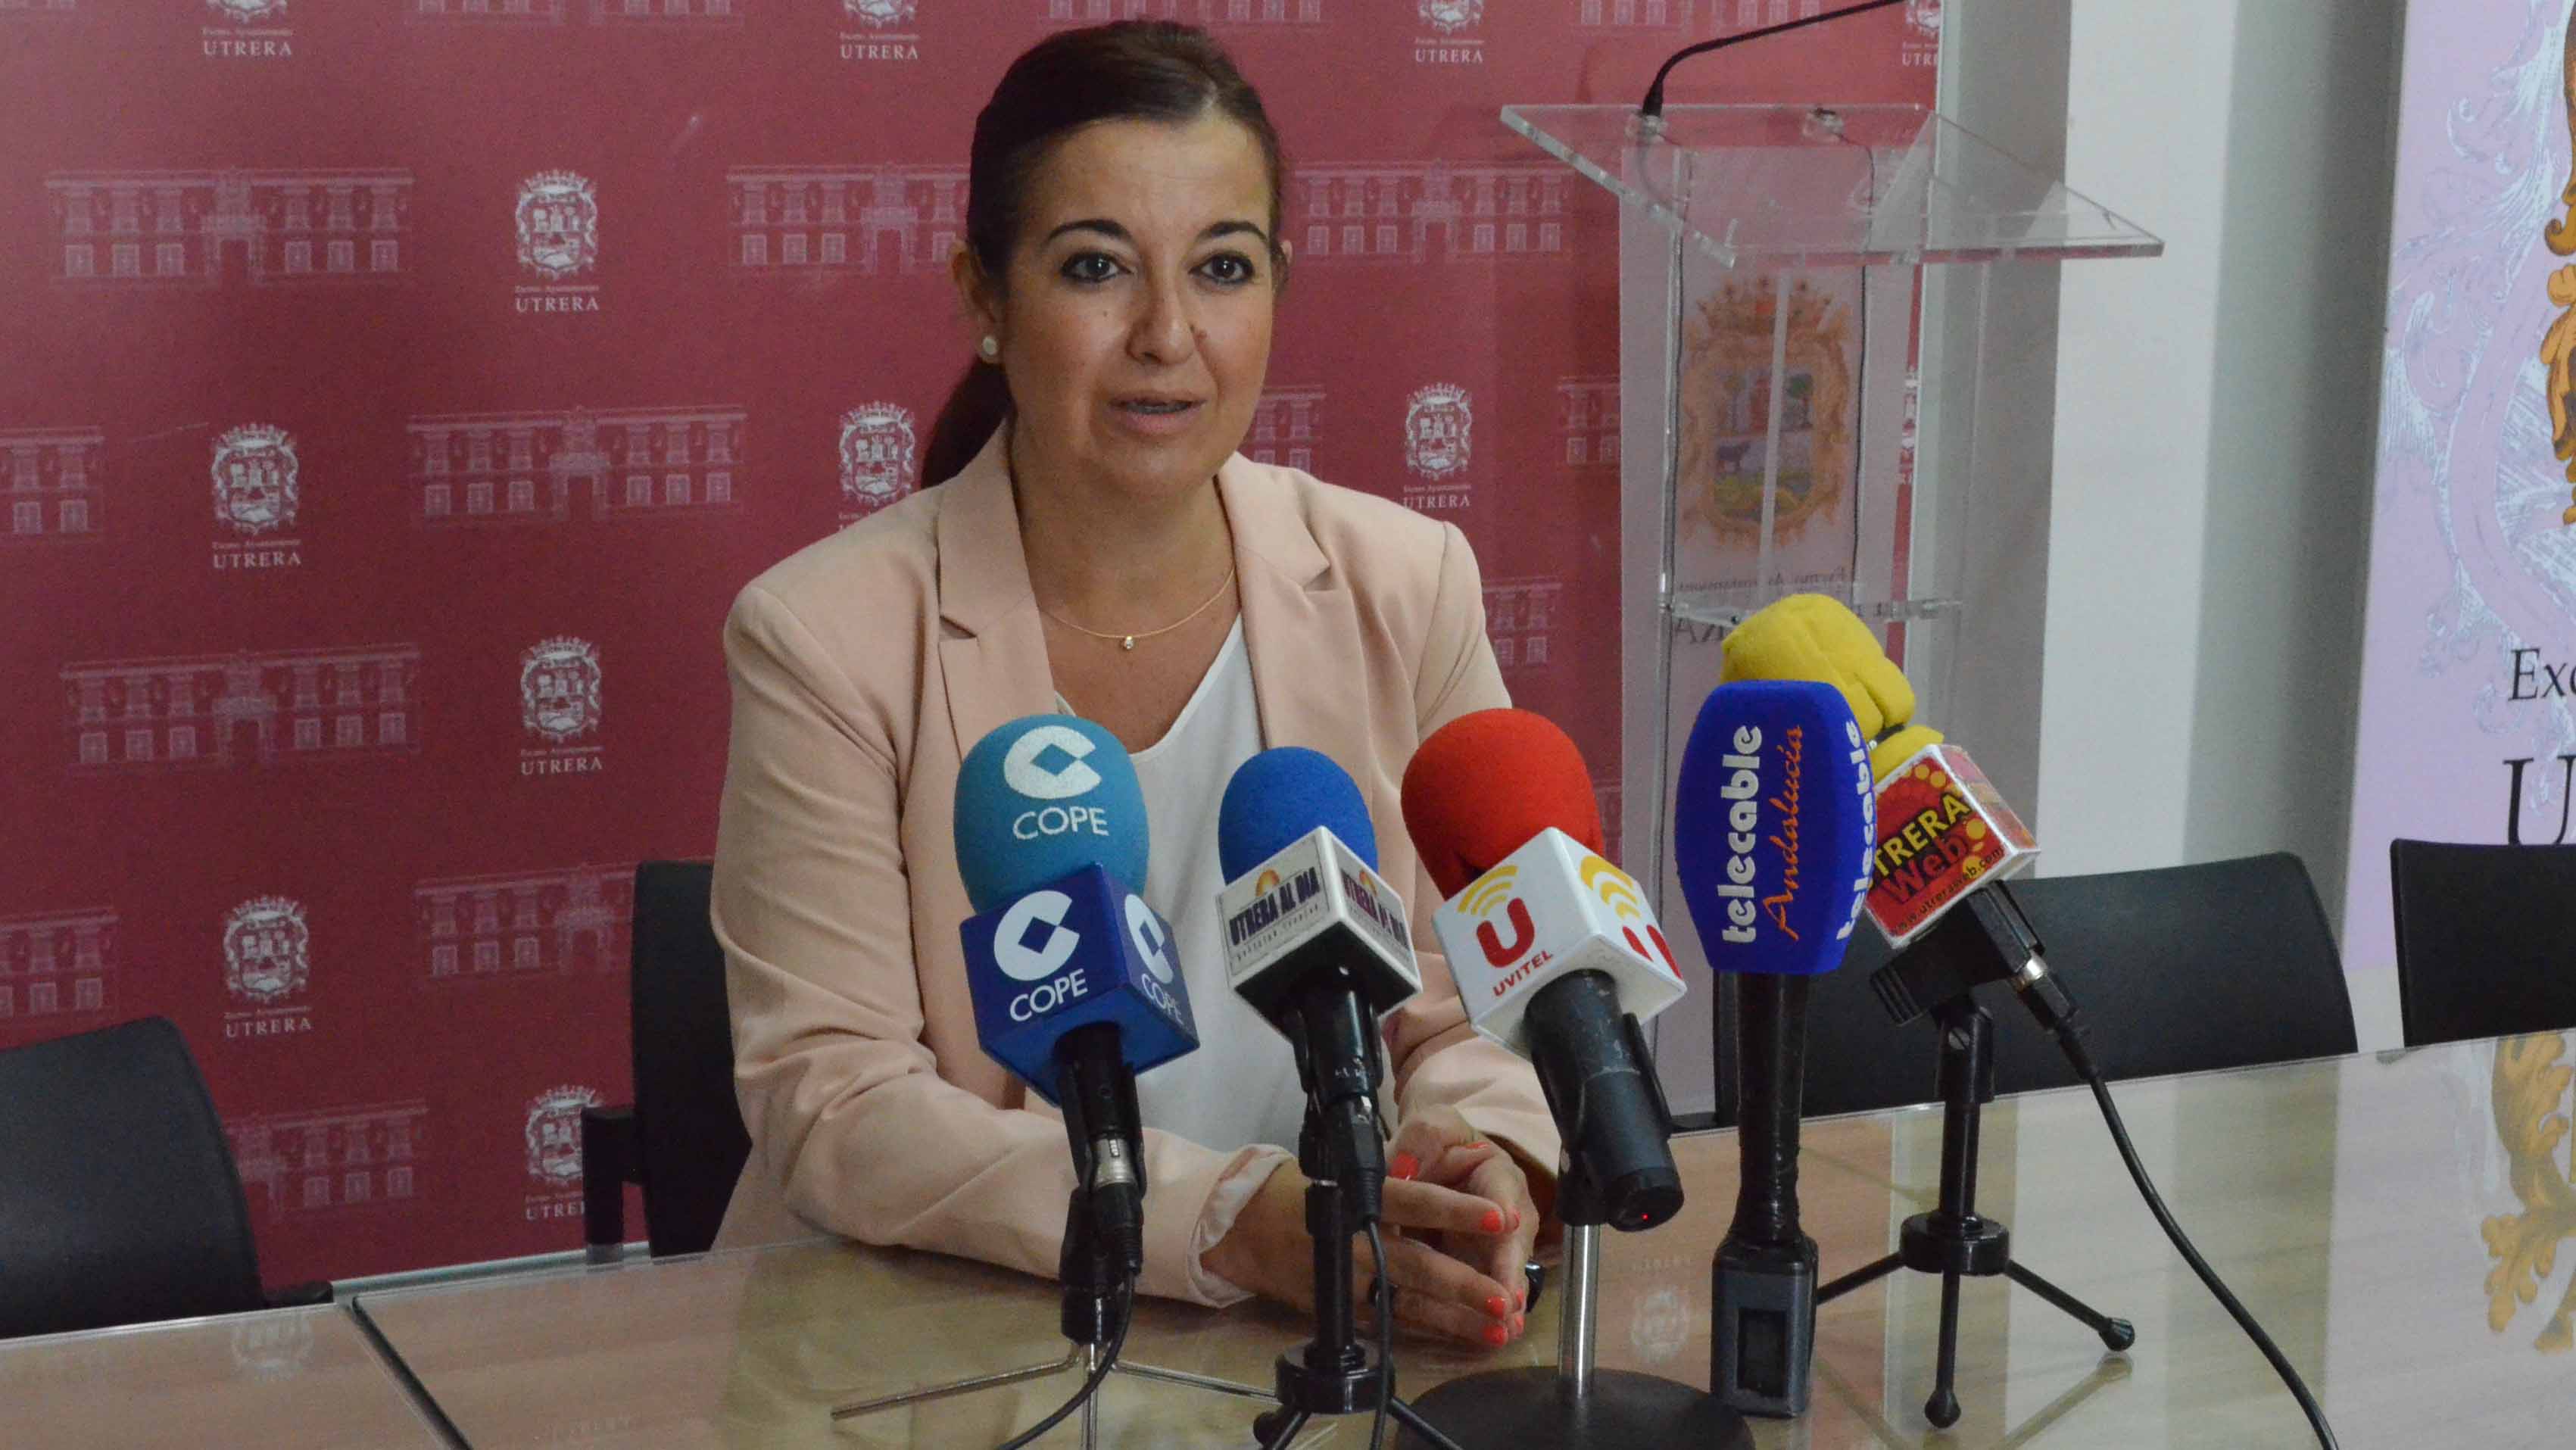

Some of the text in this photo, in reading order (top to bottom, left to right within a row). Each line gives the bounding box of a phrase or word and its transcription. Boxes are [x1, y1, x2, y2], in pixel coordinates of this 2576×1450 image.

[202, 41, 292, 55] UTRERA
[840, 44, 919, 60] UTRERA
[1414, 48, 1484, 62] UTRERA
[1902, 52, 1938, 67] UTR
[515, 296, 600, 312] UTRERA
[1403, 494, 1470, 510] UTRERA
[213, 551, 302, 569] UTRERA
[520, 756, 603, 775] UTRERA
[1013, 807, 1109, 840] COPE
[1717, 725, 1762, 943] telecable
[1872, 793, 1972, 878] TRERA
[1493, 950, 1553, 997] UVITEL
[1009, 968, 1089, 1022] COPE
[1142, 974, 1183, 1024] COPE
[226, 1017, 313, 1037] UTRERA
